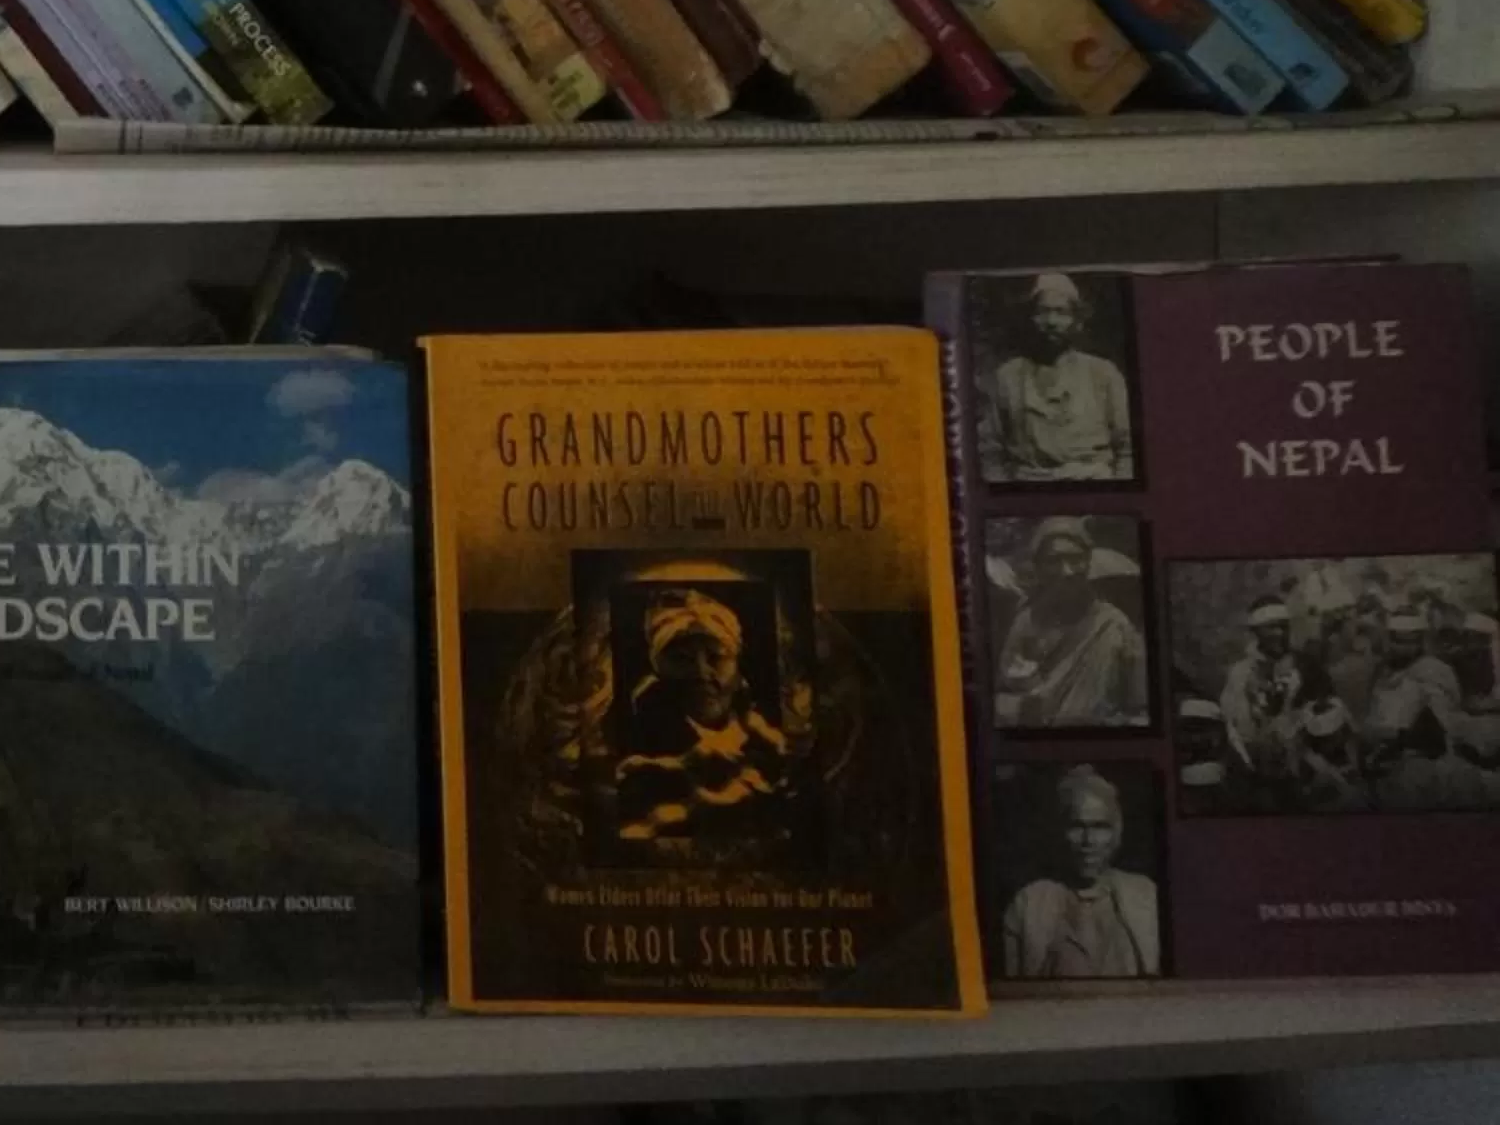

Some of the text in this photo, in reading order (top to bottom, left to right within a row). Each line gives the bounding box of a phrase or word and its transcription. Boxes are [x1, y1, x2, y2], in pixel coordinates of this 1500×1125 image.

[225, 0, 294, 79] PROCESS
[1214, 318, 1406, 364] PEOPLE
[1291, 378, 1359, 420] OF
[497, 409, 880, 468] GRANDMOTHERS
[1235, 435, 1407, 479] NEPAL
[501, 479, 686, 532] COUNSEL
[733, 479, 882, 532] WORLD
[37, 542, 241, 587] WITHIN
[64, 896, 109, 913] BERT
[208, 896, 278, 913] SHIRLEY
[283, 896, 357, 913] BOURKE
[583, 922, 858, 969] CAROL SCHAEFER
